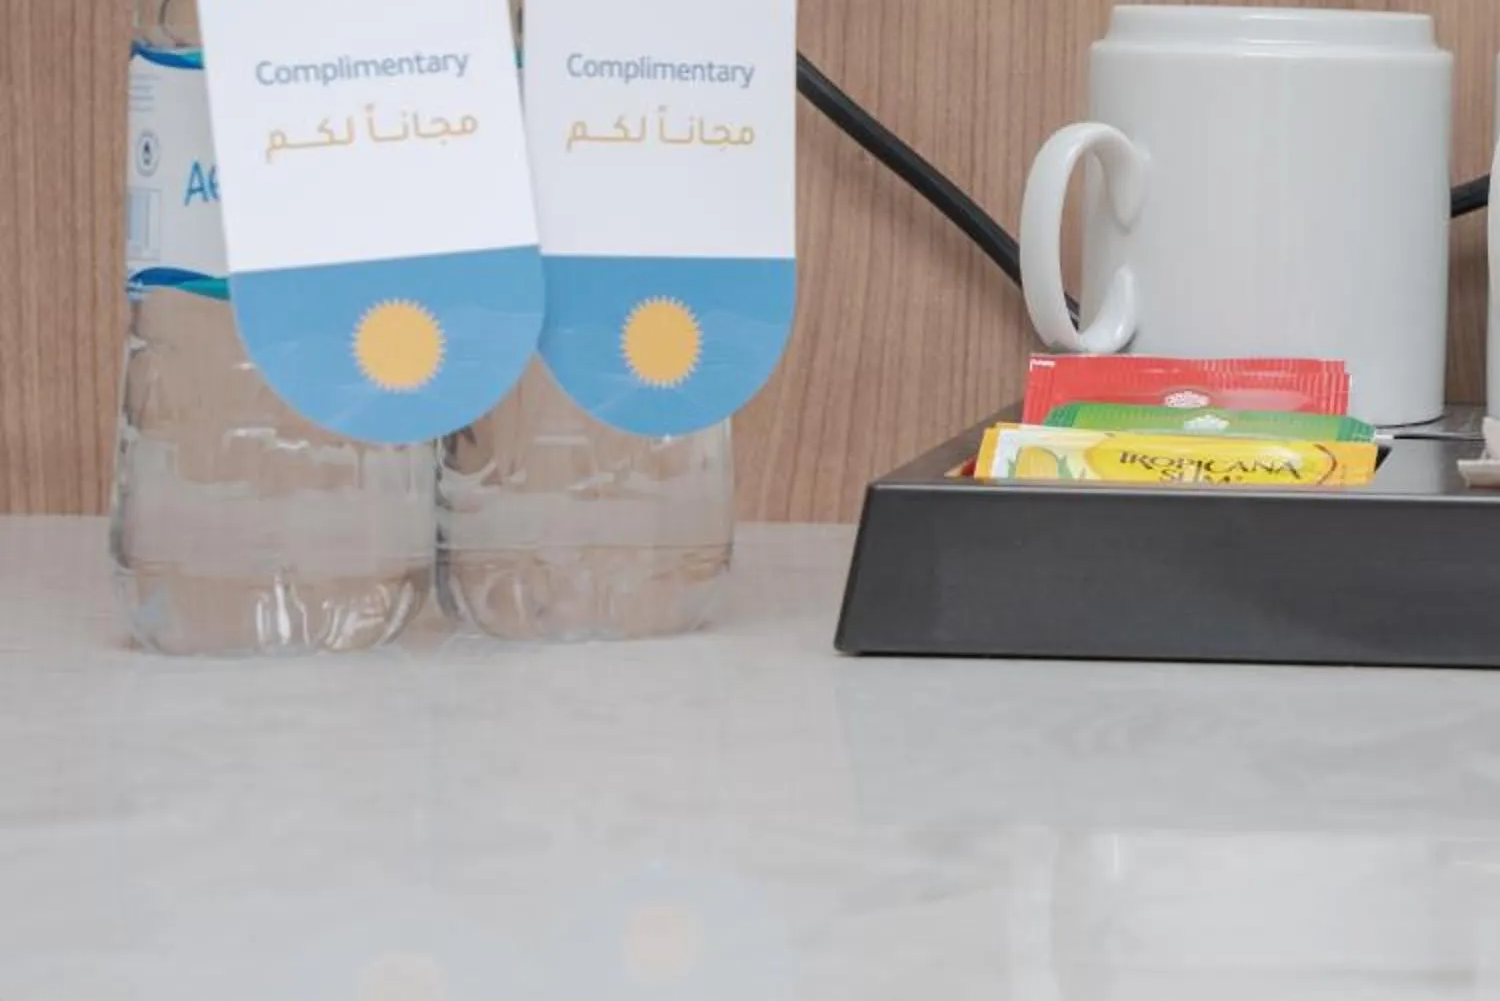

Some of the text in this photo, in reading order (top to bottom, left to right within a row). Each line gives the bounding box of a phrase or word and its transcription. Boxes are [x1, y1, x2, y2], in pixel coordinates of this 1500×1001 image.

[255, 52, 470, 87] Complimentary
[566, 52, 756, 89] Complimentary
[264, 114, 356, 165] لكم
[565, 115, 648, 154] لكم
